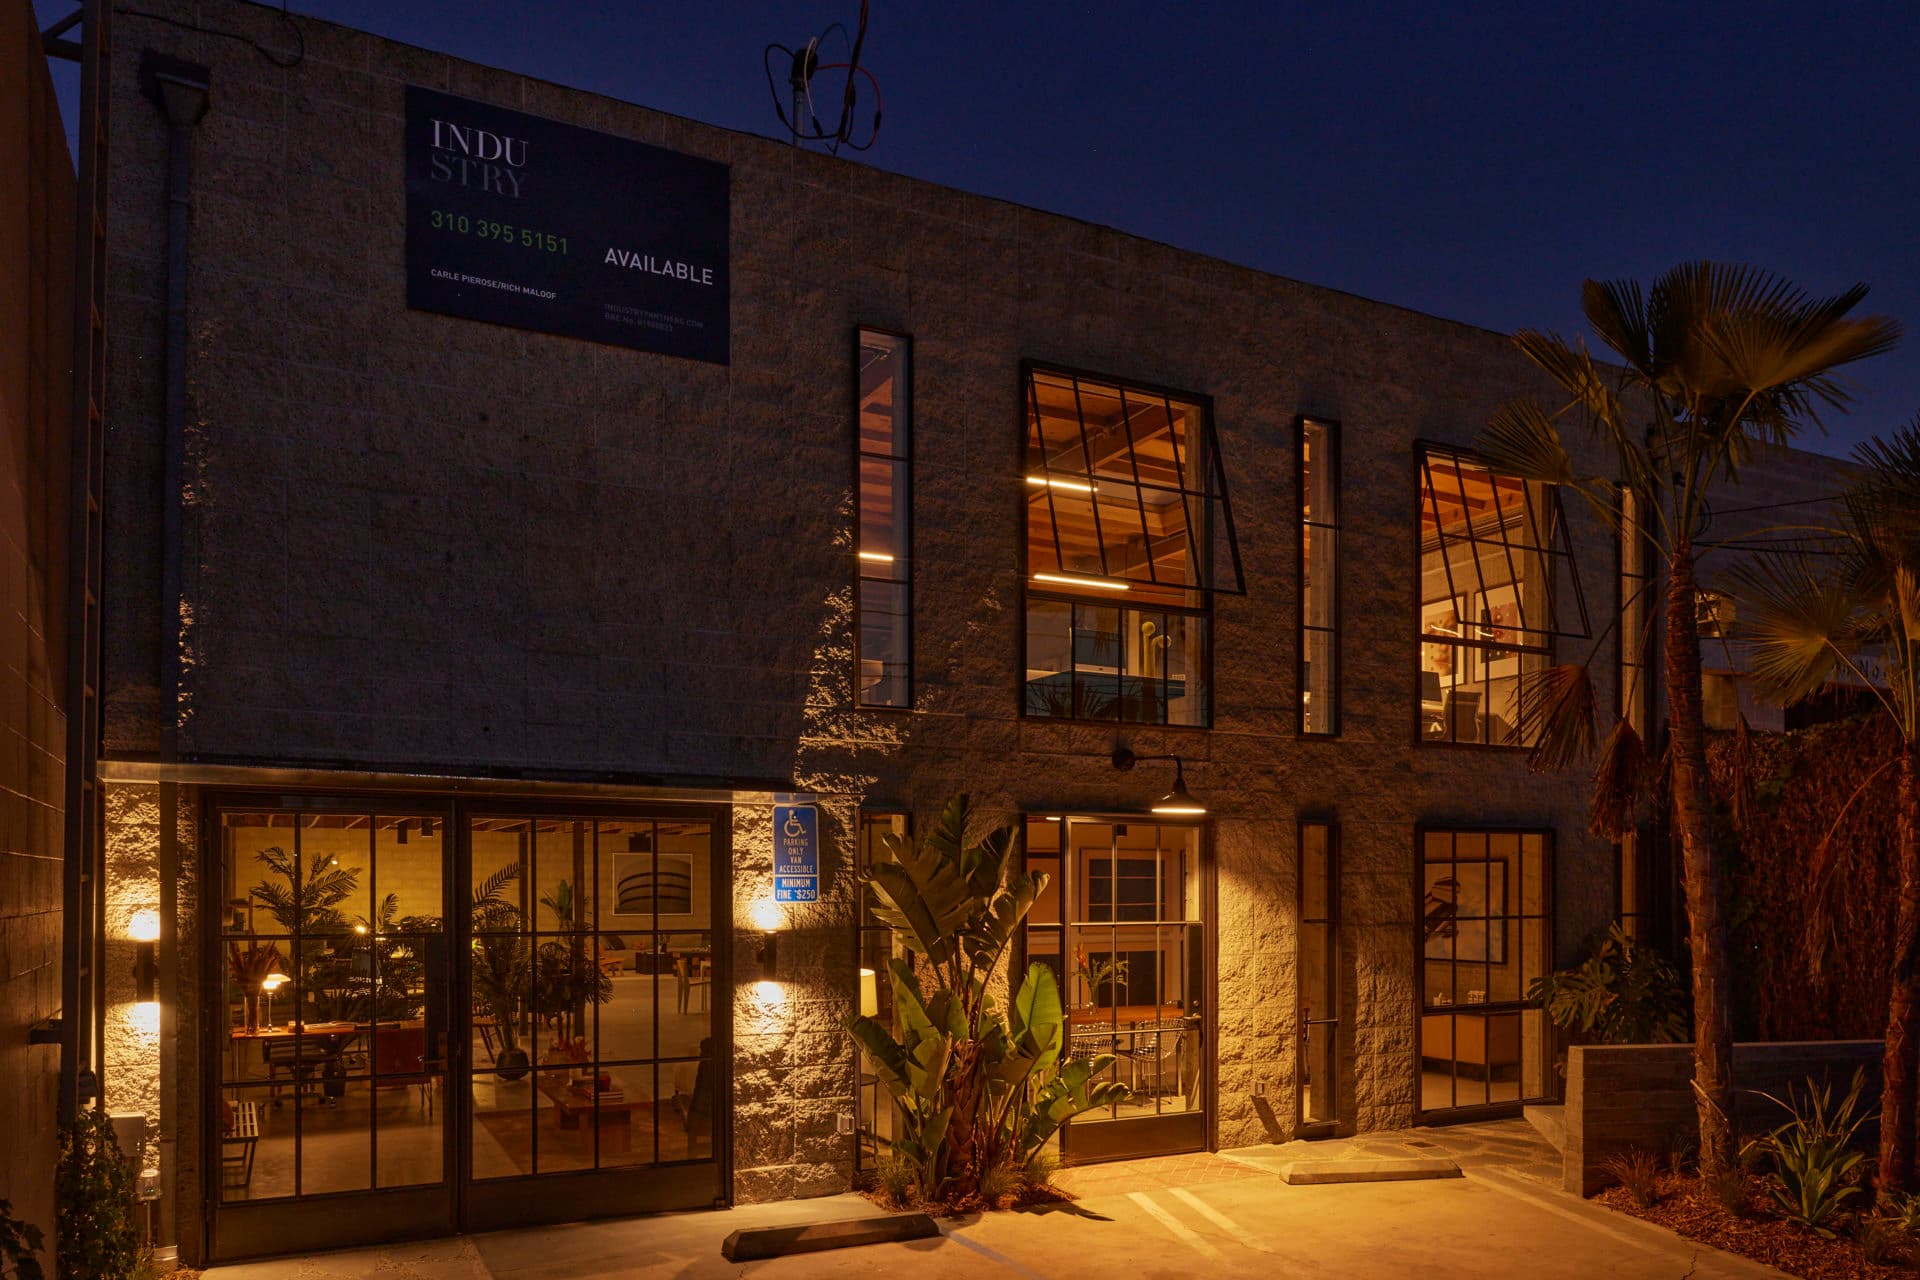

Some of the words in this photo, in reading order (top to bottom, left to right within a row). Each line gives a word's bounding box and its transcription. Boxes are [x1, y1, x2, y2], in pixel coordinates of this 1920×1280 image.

[430, 118, 529, 167] INDU
[431, 153, 527, 199] STRY
[431, 209, 469, 233] 310
[476, 219, 514, 243] 395
[521, 229, 567, 255] 5151
[604, 247, 713, 286] AVAILABLE
[430, 268, 460, 281] CARLE
[522, 286, 557, 300] MALOOF
[783, 838, 809, 847] PARKING
[788, 847, 804, 856] ONLY
[790, 856, 802, 864] VAN
[779, 865, 814, 874] ACCESSIBLE
[781, 878, 812, 888] MINIMUM
[776, 889, 792, 900] FINE
[795, 889, 817, 900] $250
